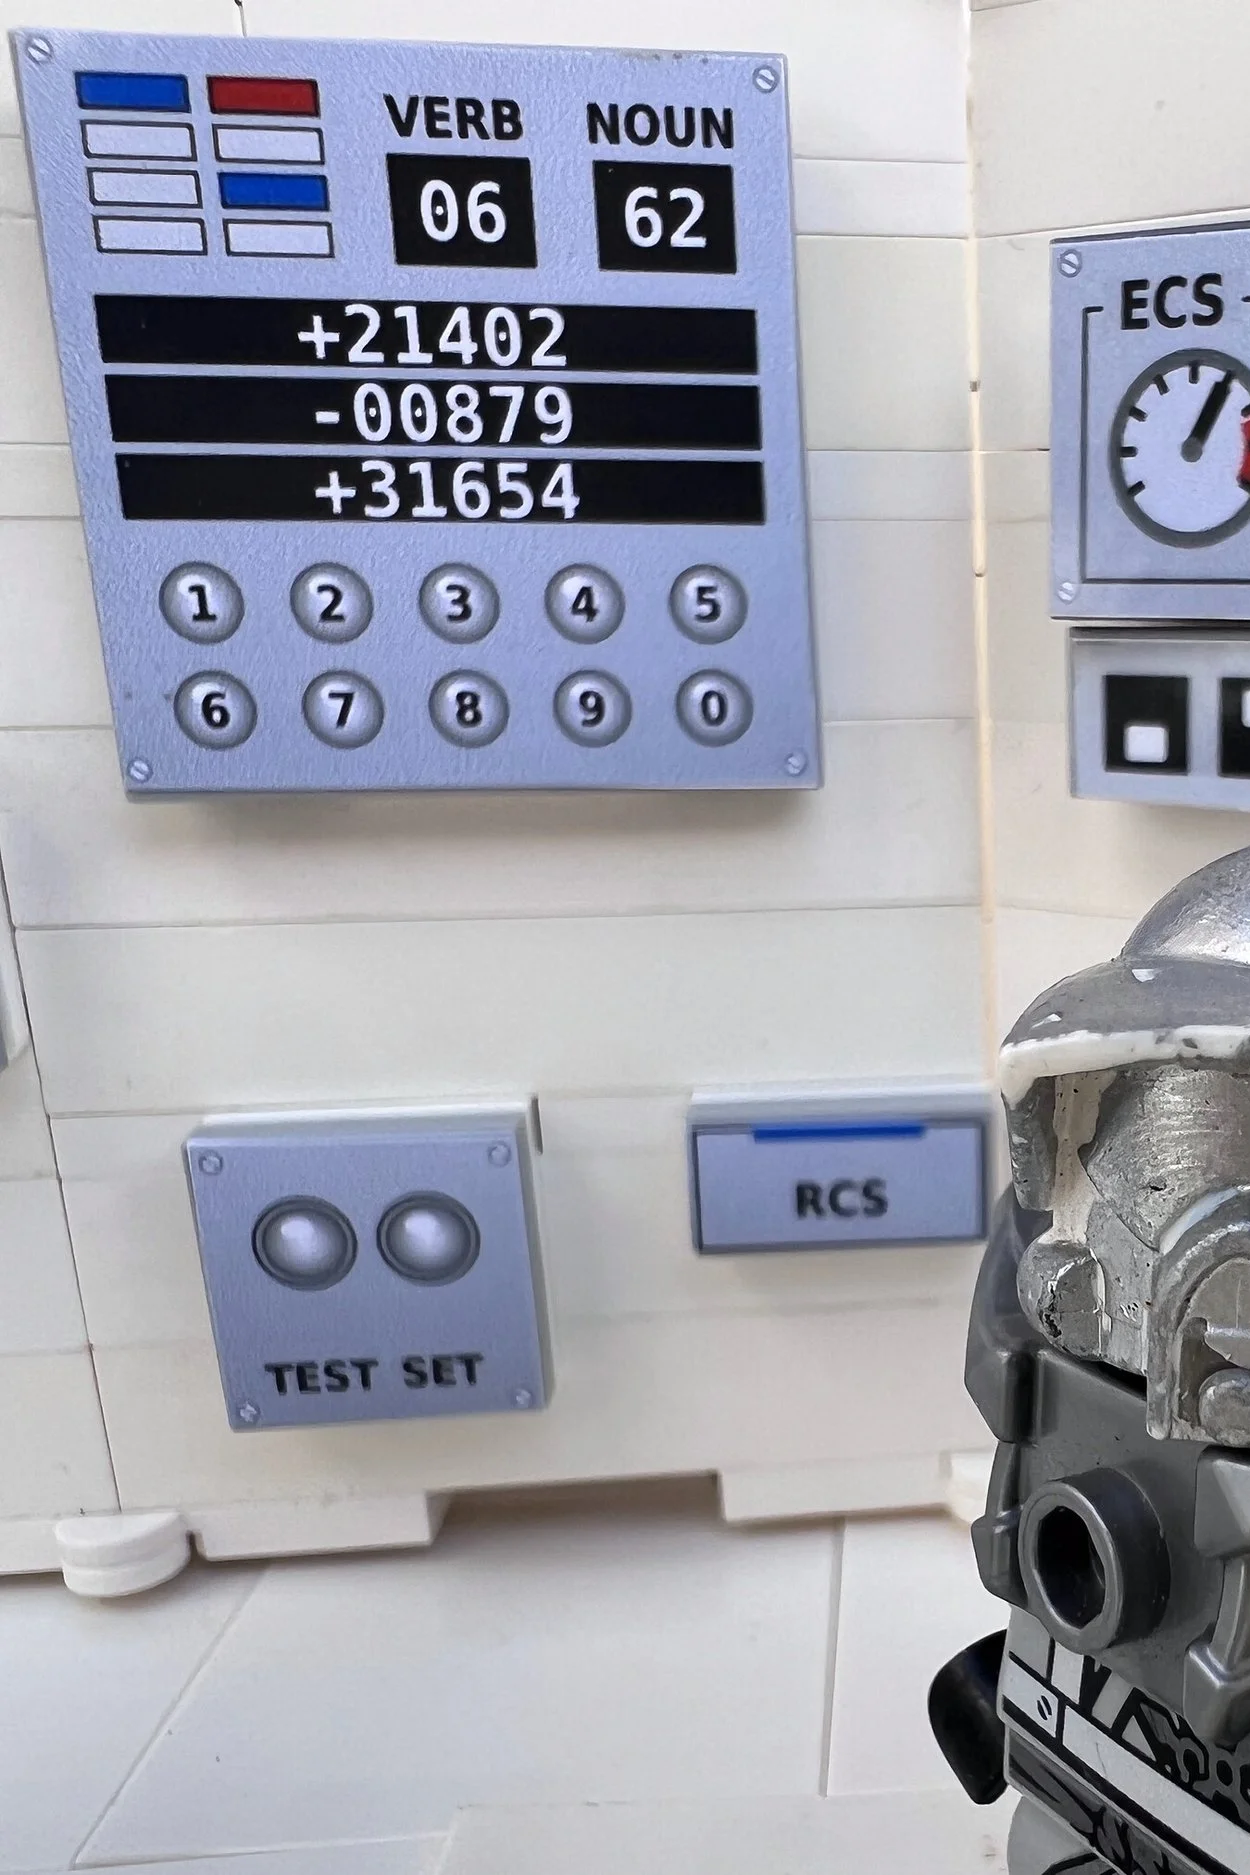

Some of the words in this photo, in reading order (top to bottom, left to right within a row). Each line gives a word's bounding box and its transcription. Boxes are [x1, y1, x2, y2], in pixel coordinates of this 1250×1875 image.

[383, 93, 524, 141] VERB
[586, 102, 735, 149] NOUN
[419, 179, 507, 243] 06
[624, 187, 707, 248] 62
[1120, 272, 1224, 330] ECS
[297, 304, 567, 367] +21402
[315, 383, 573, 444] -00879
[315, 460, 580, 520] +31654
[188, 583, 218, 622] 1
[317, 583, 343, 622] 2
[446, 584, 472, 624] 3
[569, 584, 600, 623] 4
[695, 584, 720, 622] 5
[201, 690, 229, 729] 6
[329, 690, 356, 730] 7
[455, 690, 482, 730] 8
[578, 691, 604, 729] 9
[701, 690, 727, 727] 0
[794, 1178, 889, 1218] RCS
[263, 1358, 379, 1396] TEST
[402, 1353, 485, 1390] SET
